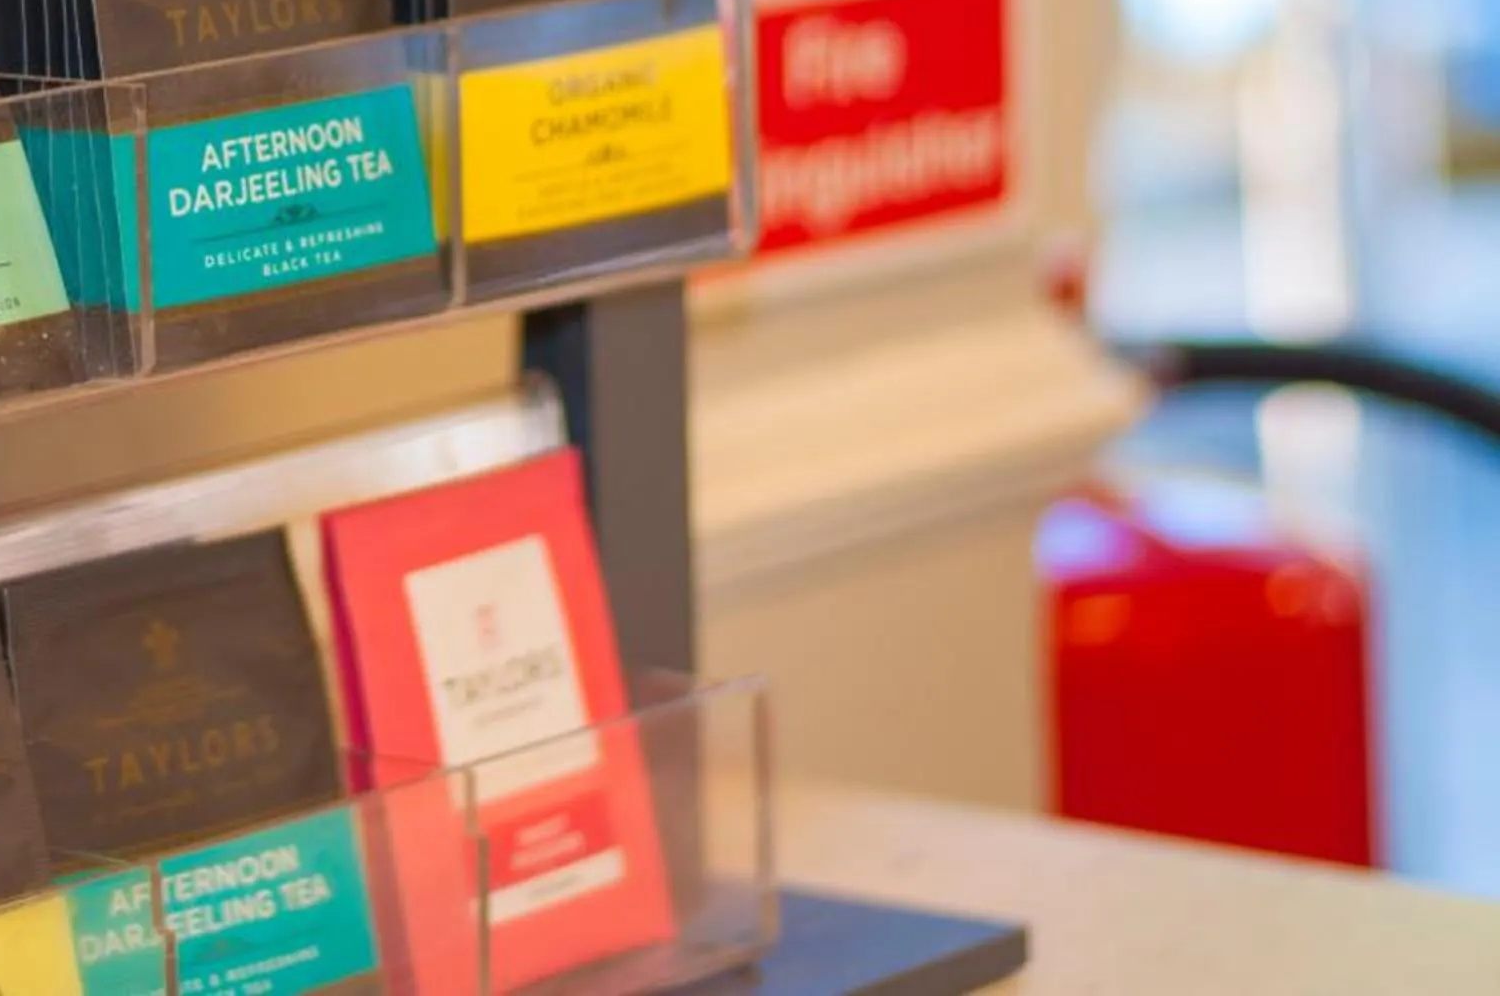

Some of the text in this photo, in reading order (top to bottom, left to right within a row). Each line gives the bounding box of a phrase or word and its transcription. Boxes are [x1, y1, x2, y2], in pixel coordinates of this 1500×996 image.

[201, 116, 364, 173] AFTERNOON
[169, 149, 393, 217] DARJEELING TEA
[204, 242, 279, 269] DELICATE
[263, 251, 342, 277] BLACK TEA
[83, 714, 280, 794] TAYLORS
[110, 844, 298, 917] AFTERNOON
[279, 873, 332, 910] TEA
